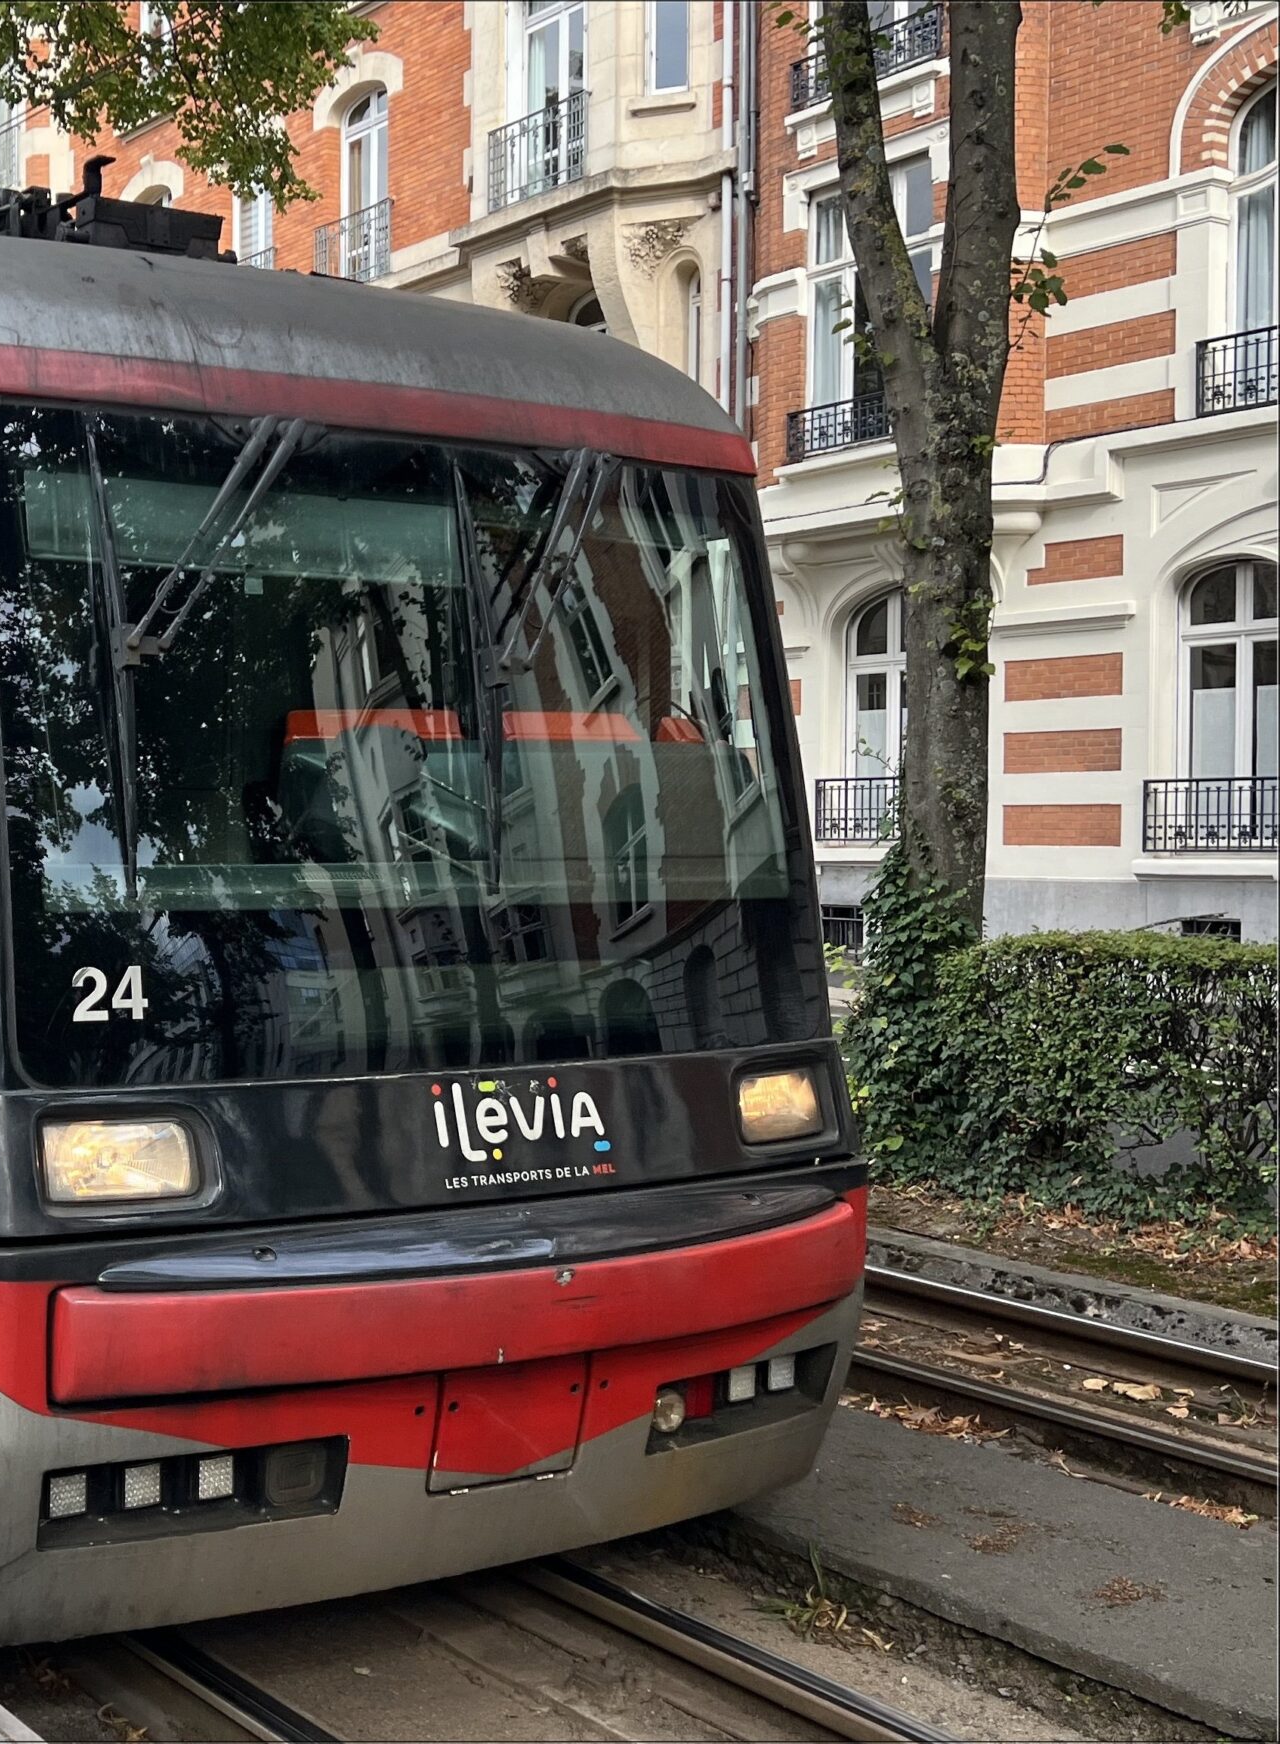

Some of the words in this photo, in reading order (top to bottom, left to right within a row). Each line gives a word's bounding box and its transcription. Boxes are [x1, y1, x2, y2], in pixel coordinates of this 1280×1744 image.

[71, 965, 149, 1022] 24
[445, 1176, 469, 1190] LES
[471, 1168, 553, 1187] TRANSPORTS
[556, 1167, 572, 1179] DE
[574, 1165, 590, 1177] LA
[592, 1163, 617, 1175] MEL
